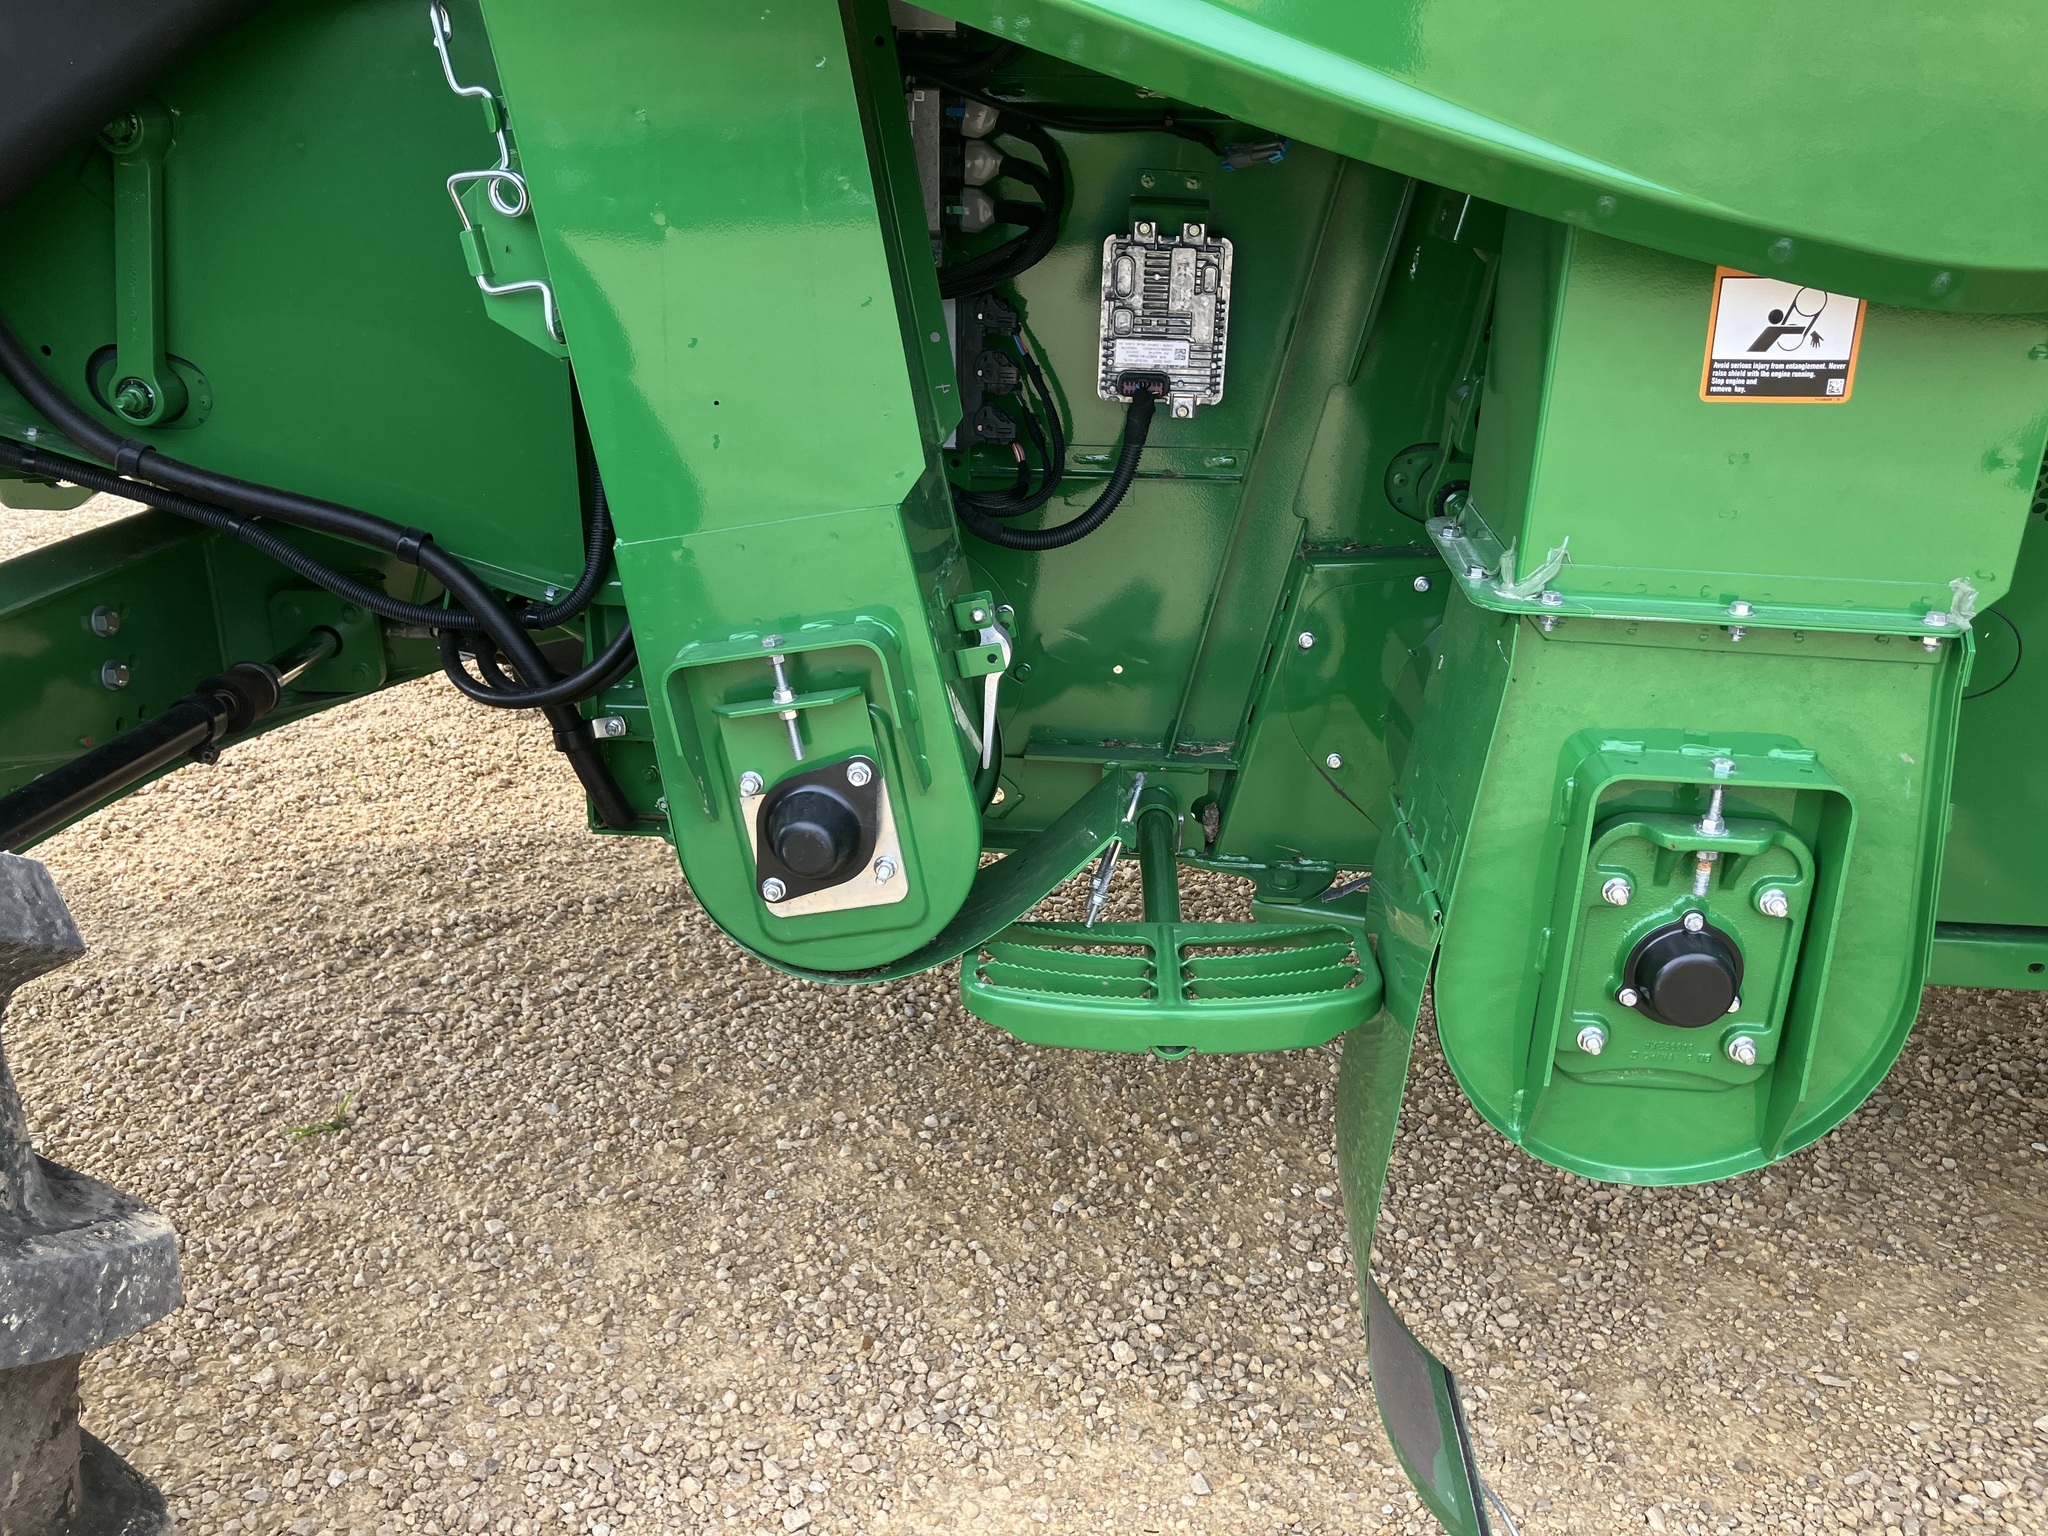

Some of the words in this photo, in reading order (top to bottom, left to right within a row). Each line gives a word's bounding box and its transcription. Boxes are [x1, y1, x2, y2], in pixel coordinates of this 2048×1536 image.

[1752, 362, 1770, 371] injury
[1785, 362, 1827, 371] entanglement.
[1828, 362, 1847, 370] Never
[1770, 371, 1791, 379] engine
[1791, 371, 1816, 379] running.
[1725, 378, 1745, 386] engine
[1734, 386, 1746, 394] key.
